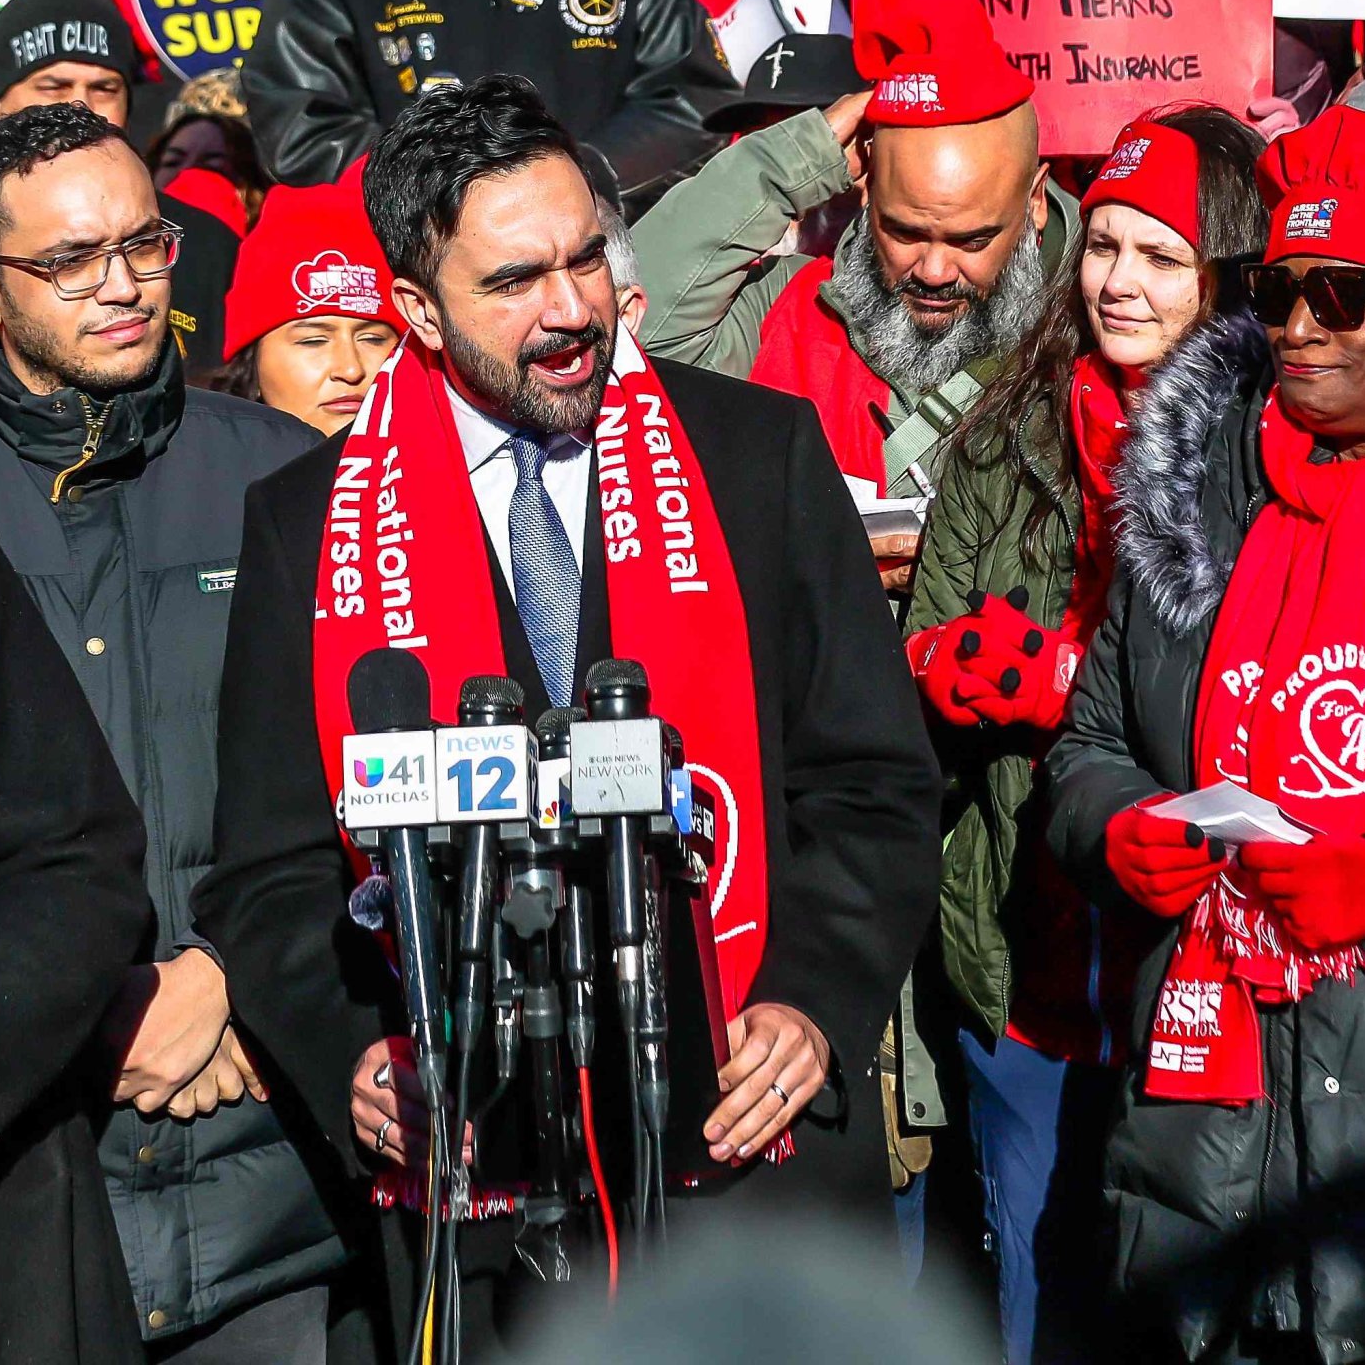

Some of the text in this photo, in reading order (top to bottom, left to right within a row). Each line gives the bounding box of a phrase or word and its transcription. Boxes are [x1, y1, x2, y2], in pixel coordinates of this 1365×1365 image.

[9, 20, 110, 69] FIGHT CLUB
[161, 6, 262, 58] SUP
[1062, 43, 1203, 86] INSURANCE
[309, 271, 377, 290] NURSES
[594, 405, 643, 564] Nurses
[635, 393, 710, 594] National
[329, 456, 373, 619] Nurses
[374, 445, 429, 649] National
[1270, 643, 1358, 713] PROUD
[1317, 700, 1355, 721] For
[445, 733, 516, 753] news
[614, 754, 641, 763] NEWS
[389, 754, 428, 786] 41
[447, 755, 518, 813] 12
[578, 764, 655, 779] NEW YORK
[350, 789, 430, 806] NOTICIAS
